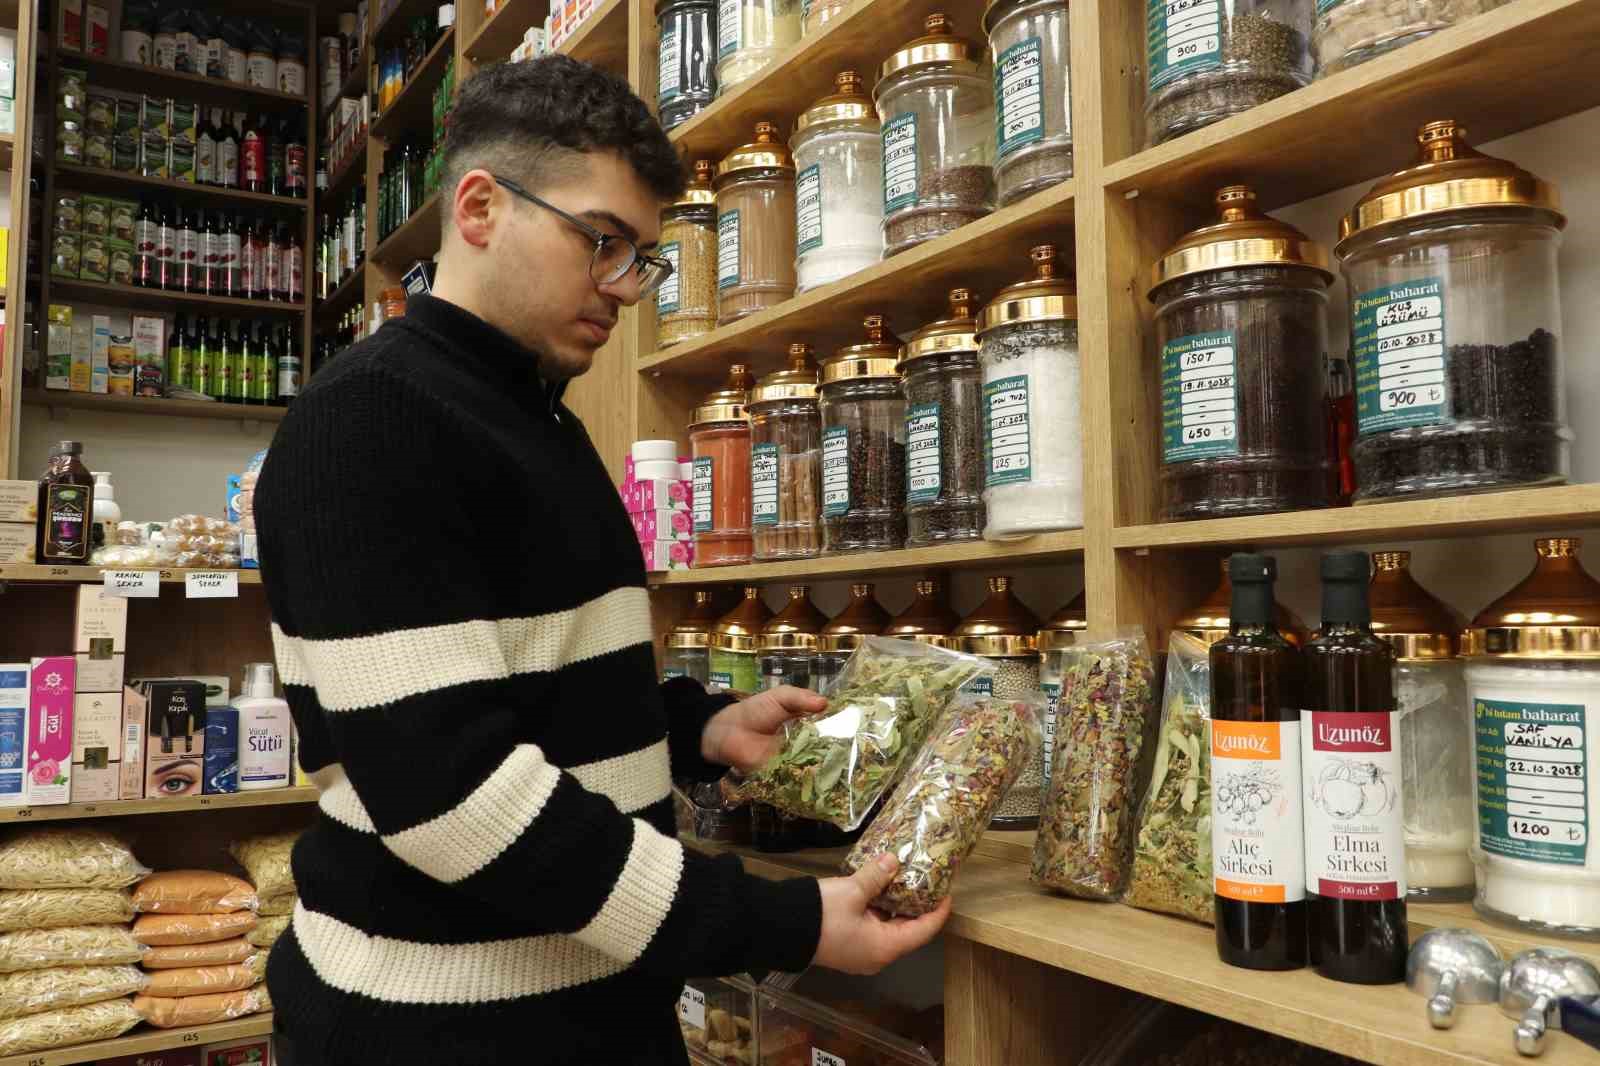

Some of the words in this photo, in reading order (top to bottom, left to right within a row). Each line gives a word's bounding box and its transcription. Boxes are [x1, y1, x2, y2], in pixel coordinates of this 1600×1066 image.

[1177, 44, 1197, 57] 900
[1390, 283, 1439, 300] baharat
[1191, 335, 1233, 349] baharat
[48, 714, 59, 734] Gül
[1522, 709, 1581, 723] baharat
[1319, 723, 1384, 746] Uzunöz
[1514, 724, 1547, 734] SAF
[249, 735, 282, 752] Sütü
[1215, 730, 1272, 753] Uzunöz
[1506, 735, 1574, 748] VANİLYA
[1513, 822, 1550, 836] 1200
[1228, 839, 1260, 860] Alıç
[1334, 835, 1380, 853] Elma
[1220, 855, 1273, 876] Sirkesi
[1327, 854, 1388, 873] Sirkesi
[183, 1033, 200, 1042] 125
